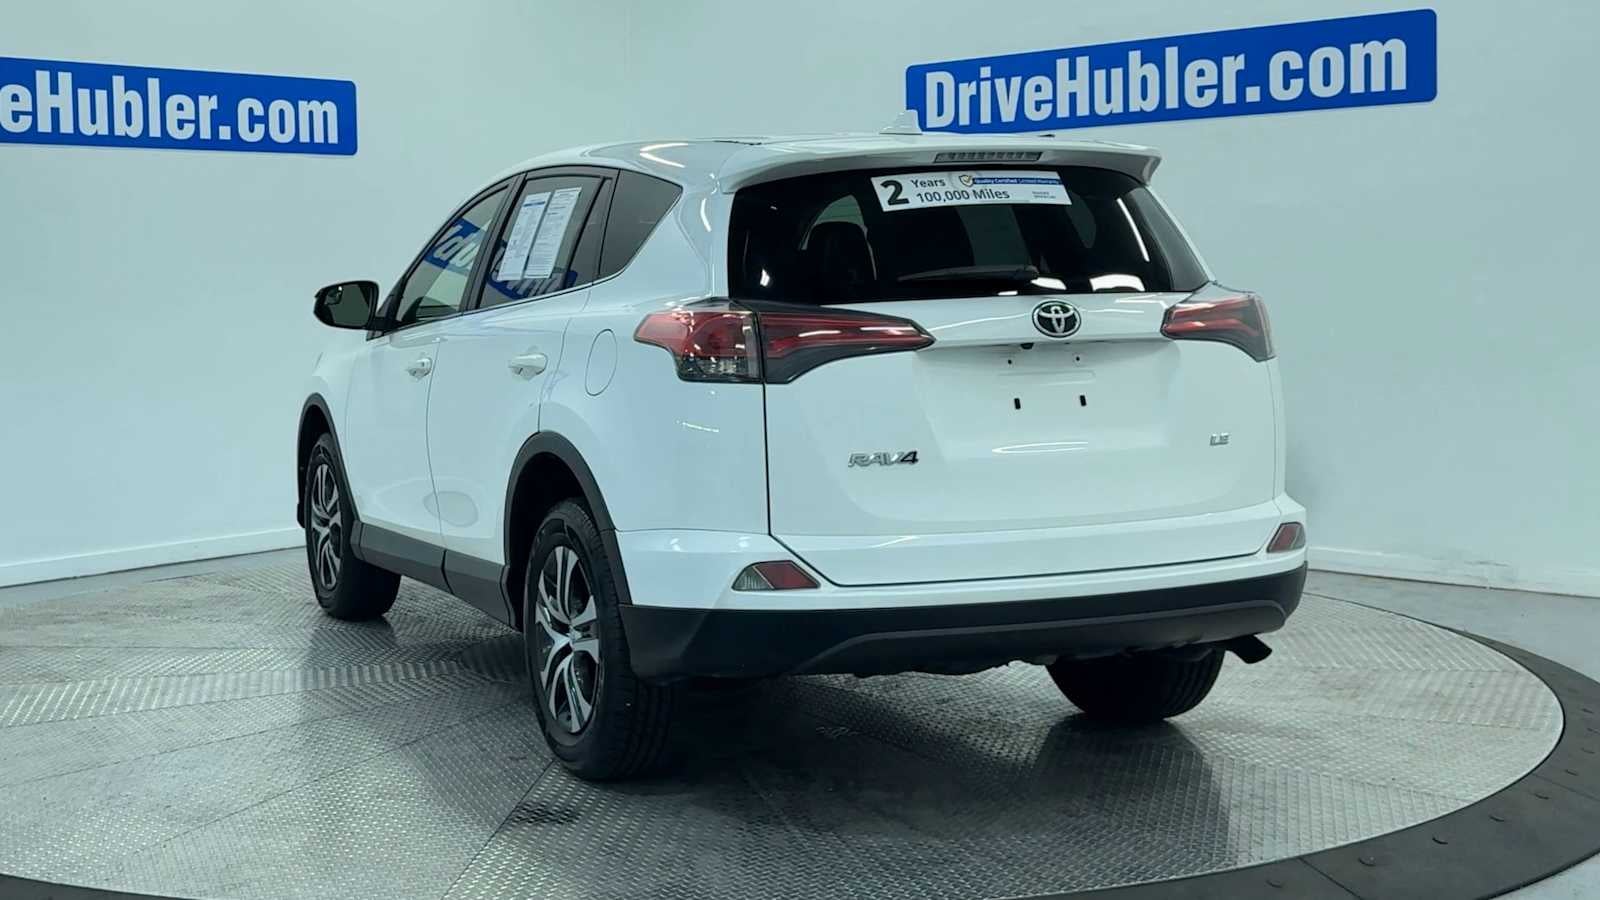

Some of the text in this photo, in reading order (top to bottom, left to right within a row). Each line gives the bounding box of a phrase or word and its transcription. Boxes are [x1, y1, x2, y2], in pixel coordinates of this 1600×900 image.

[925, 37, 1407, 129] DriveHubler.com
[0, 69, 339, 145] eHubler.com
[911, 178, 946, 188] Years
[880, 179, 910, 206] 2
[916, 188, 1010, 203] 100,000 Miles
[1209, 433, 1229, 446] LE
[848, 450, 919, 468] RAV4
